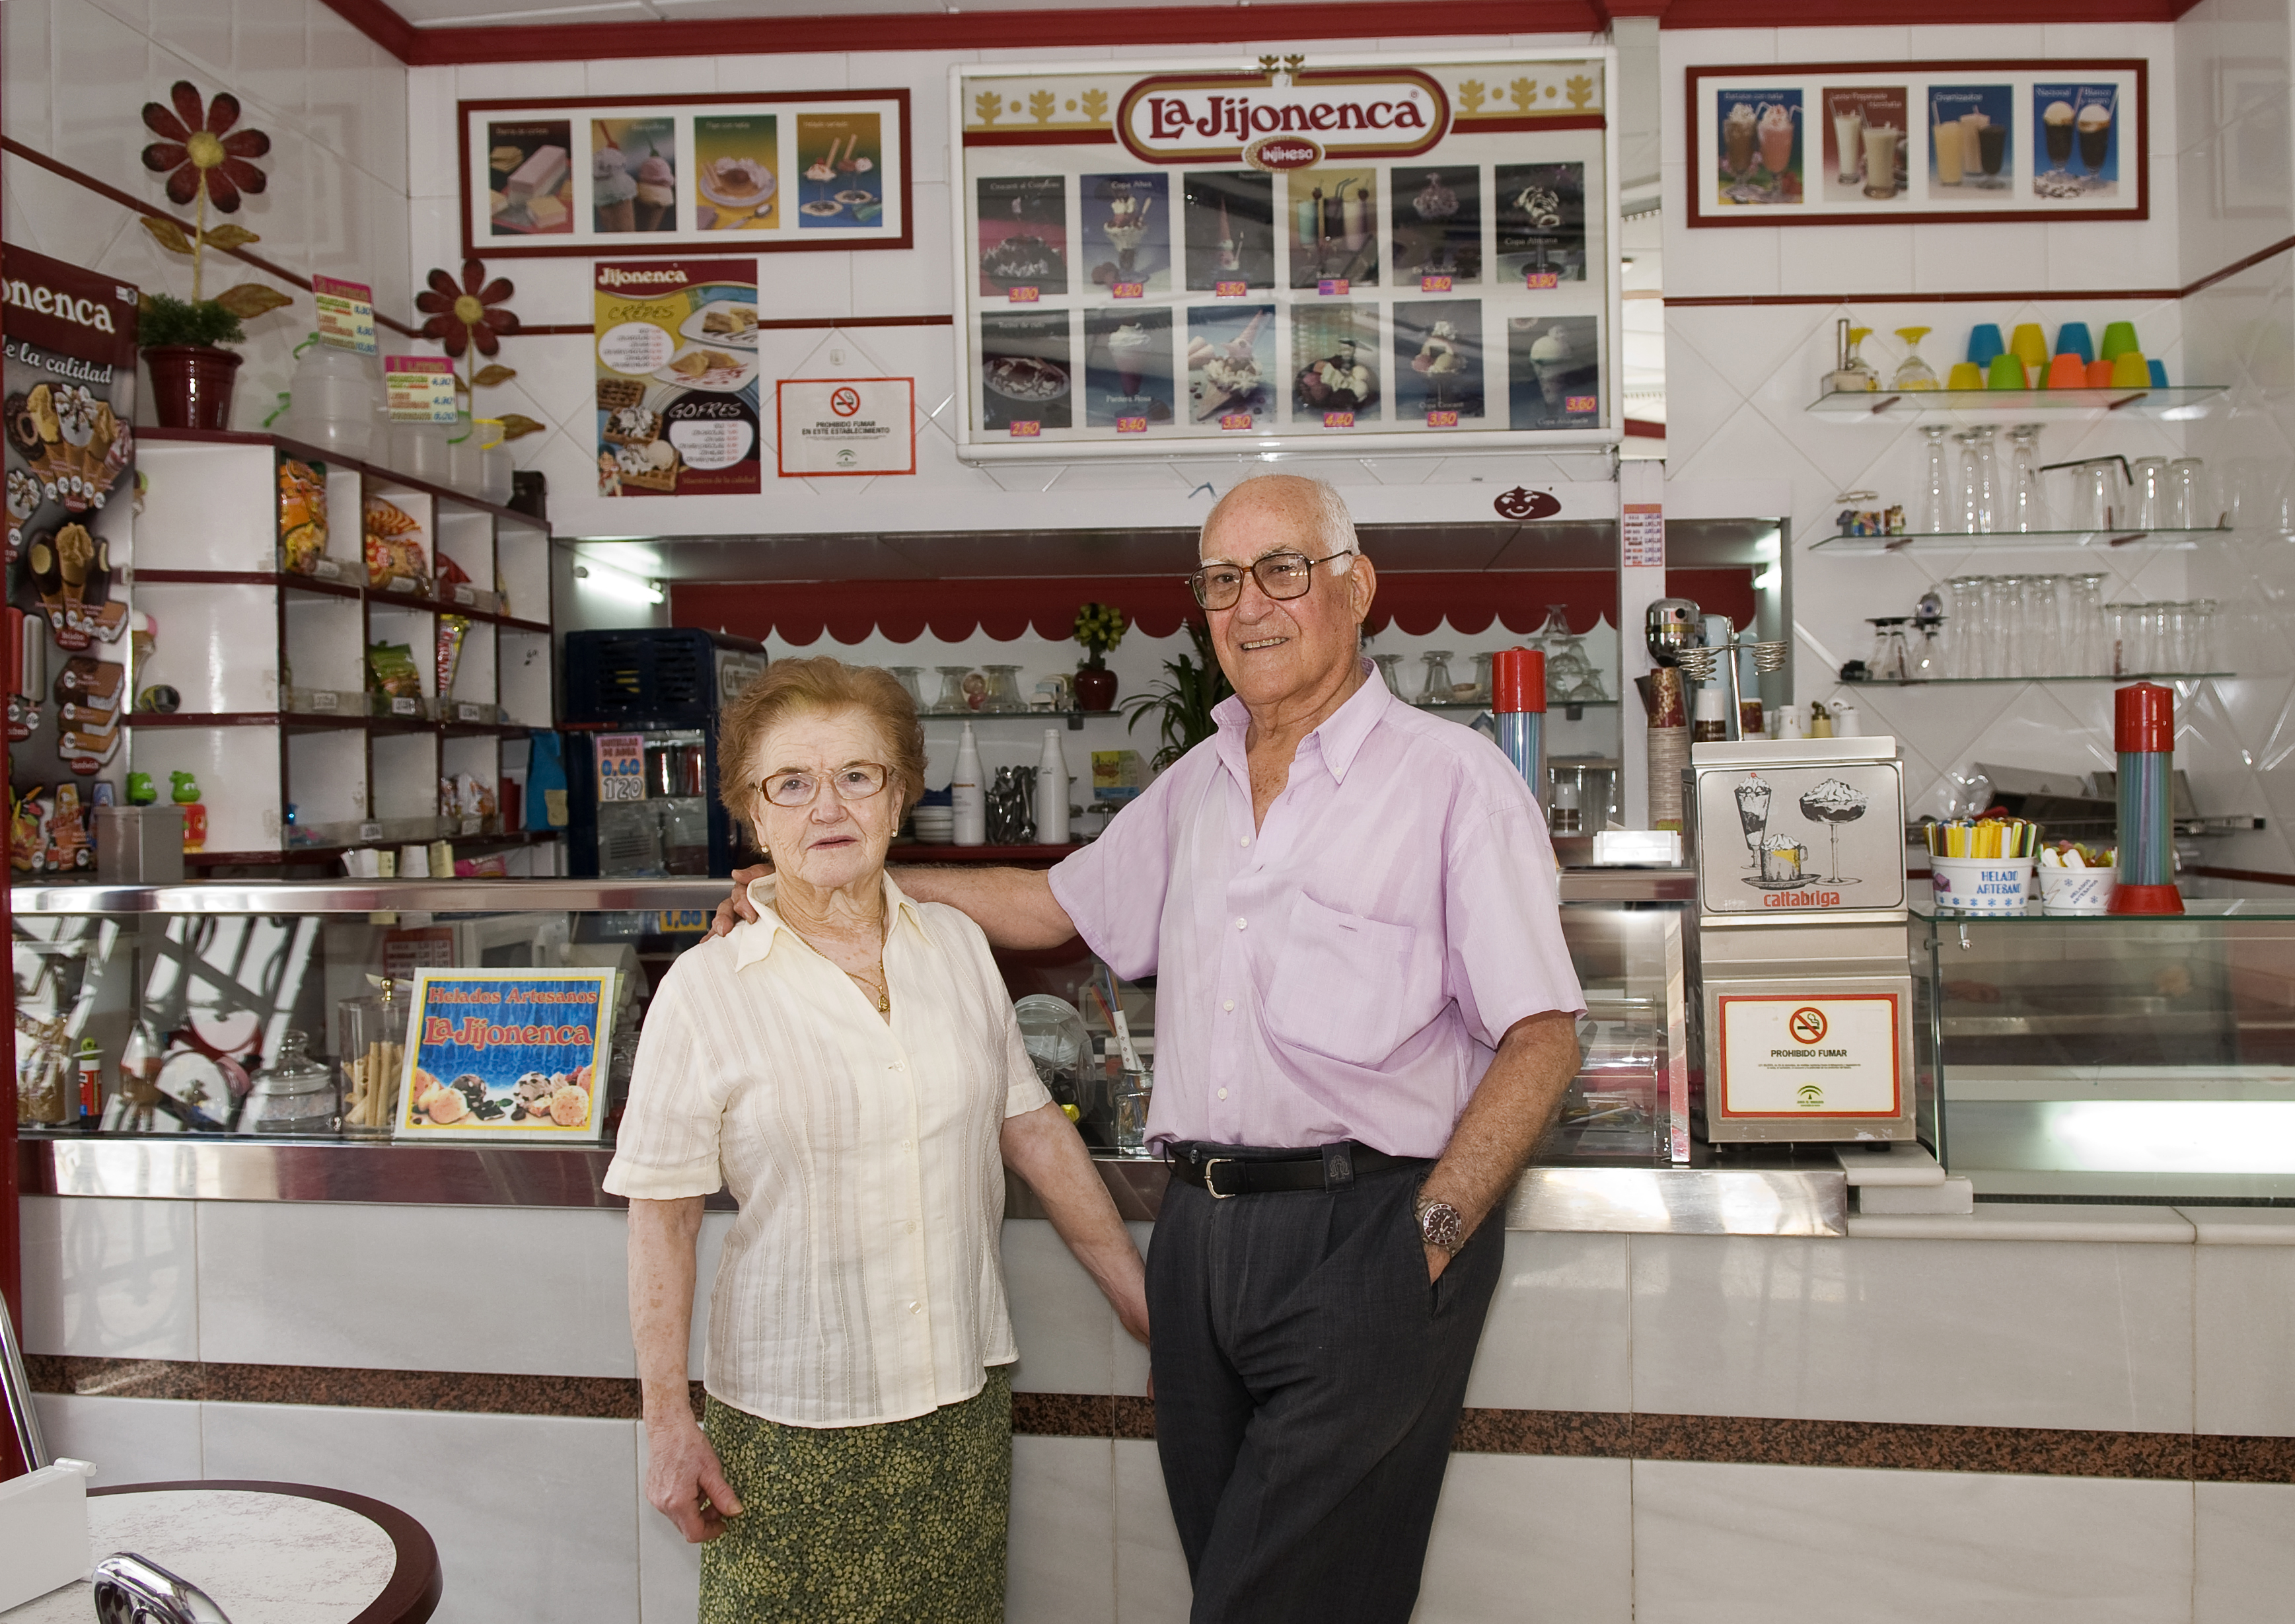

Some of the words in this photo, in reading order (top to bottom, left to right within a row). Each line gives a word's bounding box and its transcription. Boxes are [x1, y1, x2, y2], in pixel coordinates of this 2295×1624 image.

[1148, 97, 1194, 139] La
[1196, 96, 1427, 141] Jijonenca
[598, 267, 688, 287] Jijonenca
[20, 342, 41, 367] la
[46, 357, 113, 383] calidad
[669, 402, 742, 419] GOFRES
[602, 759, 640, 777] 0,60
[1981, 871, 2018, 882] HELADO
[1763, 891, 1840, 908] cattabriga
[665, 910, 702, 928] 1,00
[427, 987, 501, 1004] Helados
[505, 988, 598, 1004] Artesanos
[423, 1016, 455, 1046] La
[454, 1017, 594, 1052] Jijonenca
[1770, 1049, 1816, 1058] PROHIBIDO
[1818, 1049, 1848, 1058] FUMAR
